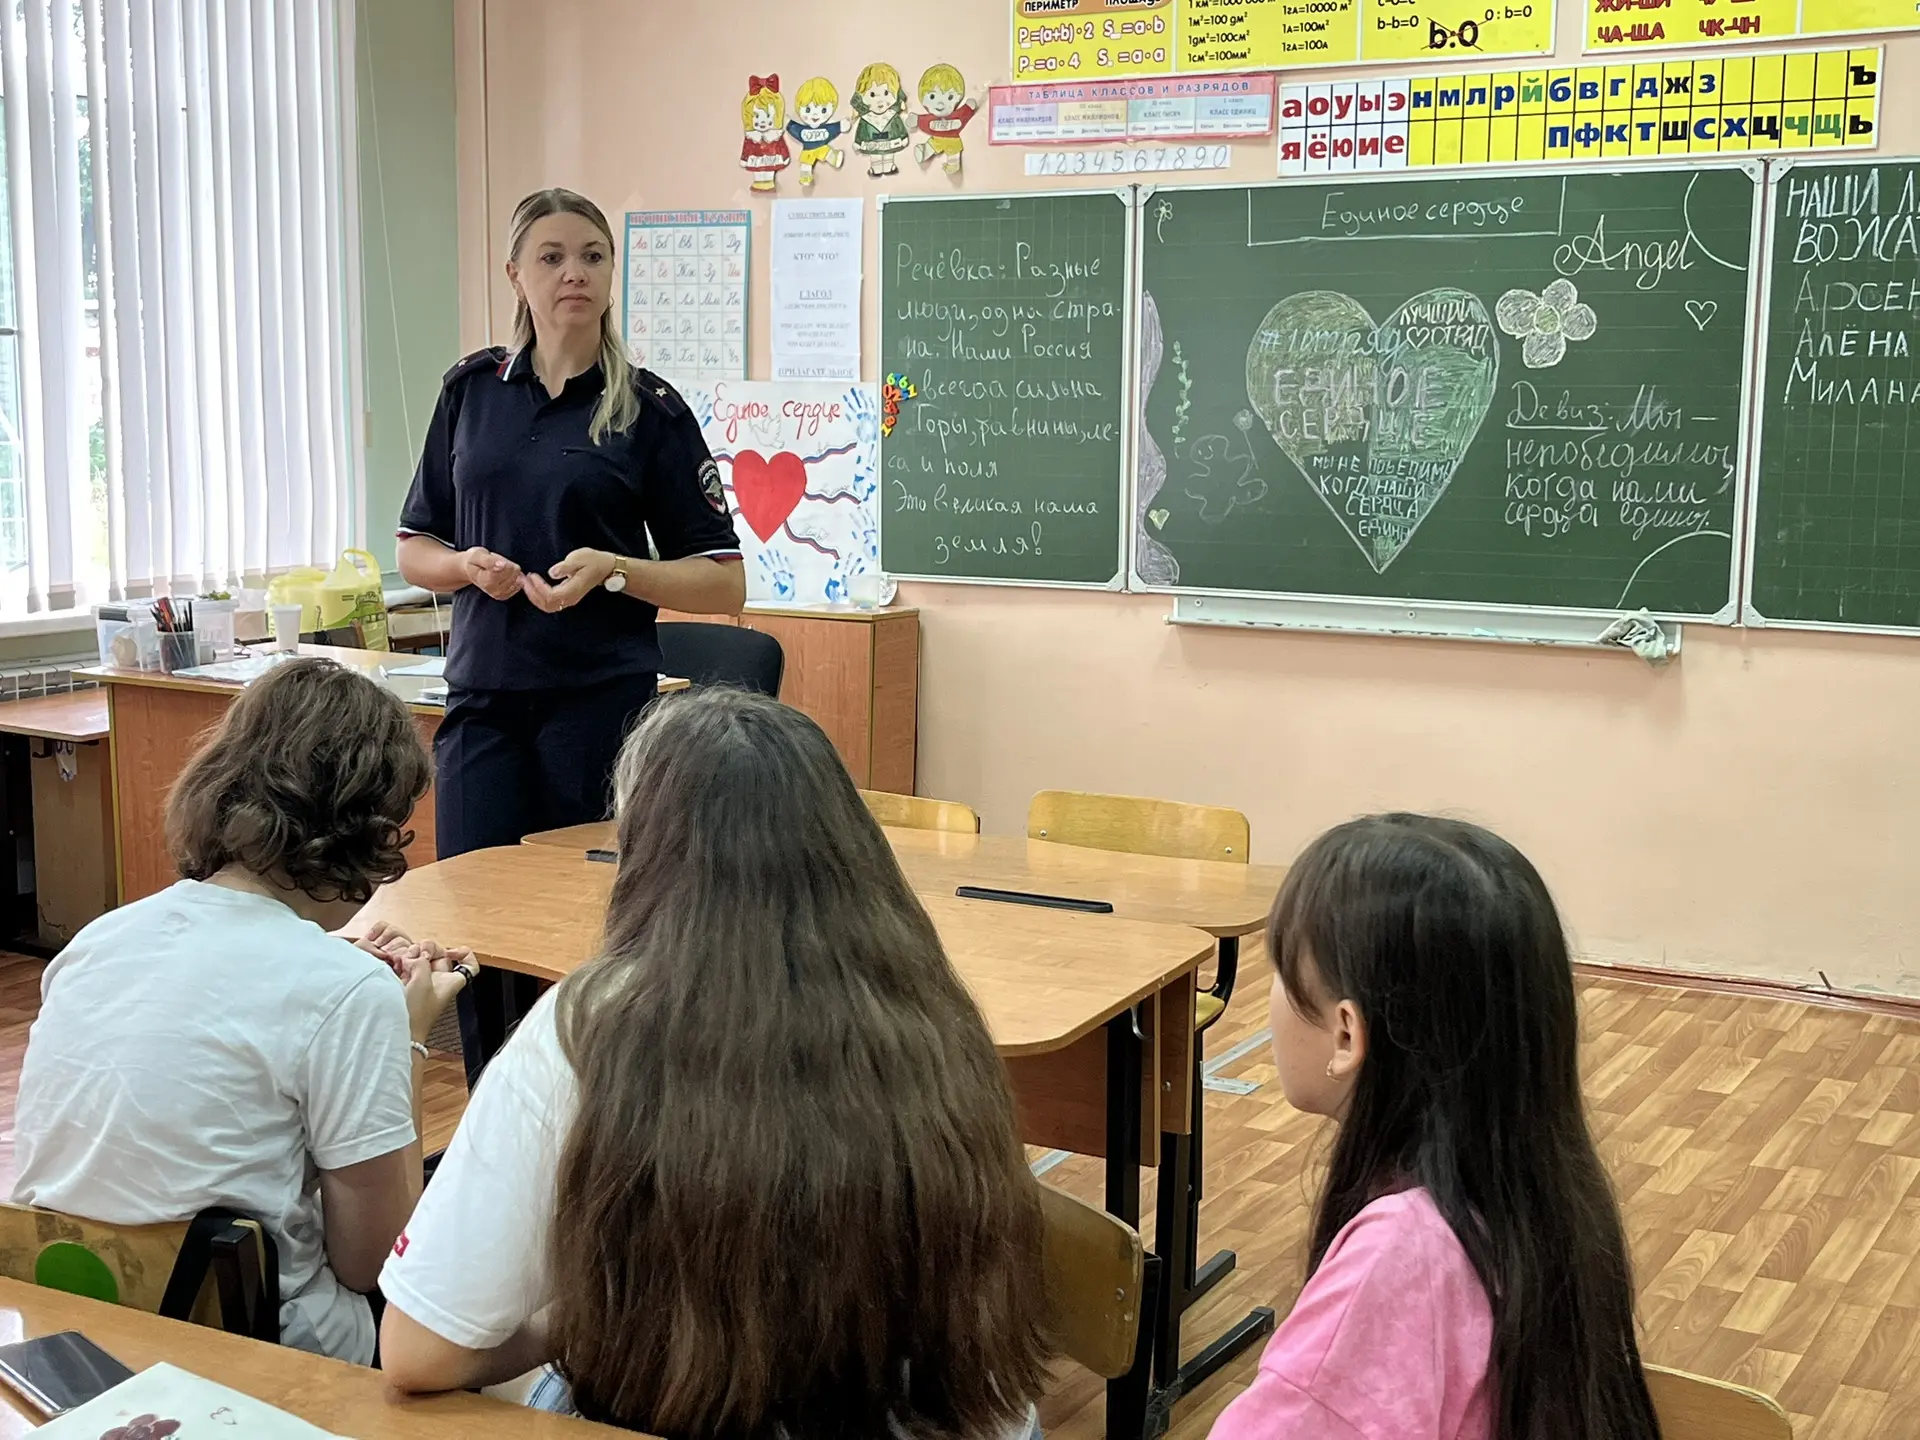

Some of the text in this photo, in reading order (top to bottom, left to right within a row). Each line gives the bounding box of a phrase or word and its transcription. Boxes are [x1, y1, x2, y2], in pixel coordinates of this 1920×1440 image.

[1699, 15, 1761, 37] ЧК-ЧН
[1029, 88, 1084, 99] ТАБЛИЦА
[1092, 85, 1154, 97] КЛАССОВ
[1177, 82, 1249, 92] РАЗРЯДОВ
[1321, 192, 1524, 236] Единое сердце
[1786, 168, 1879, 218] НАШИ
[1553, 214, 1694, 290] Angel
[1793, 214, 1920, 263] ВОЖА
[1016, 242, 1100, 298] Разные
[1021, 323, 1092, 360] Россия
[1274, 365, 1447, 408] ЕДИНОЕ
[1505, 380, 1682, 432] Девиз: Мы
[713, 382, 841, 443] Единое сердце
[1279, 407, 1434, 448] СЕРДЦЕ
[921, 456, 934, 473] и
[945, 459, 998, 477] поля
[892, 480, 1099, 515] Это великая наша
[1505, 472, 1708, 512] когда наши
[1505, 501, 1599, 537] сердца
[932, 521, 1042, 564] земля!
